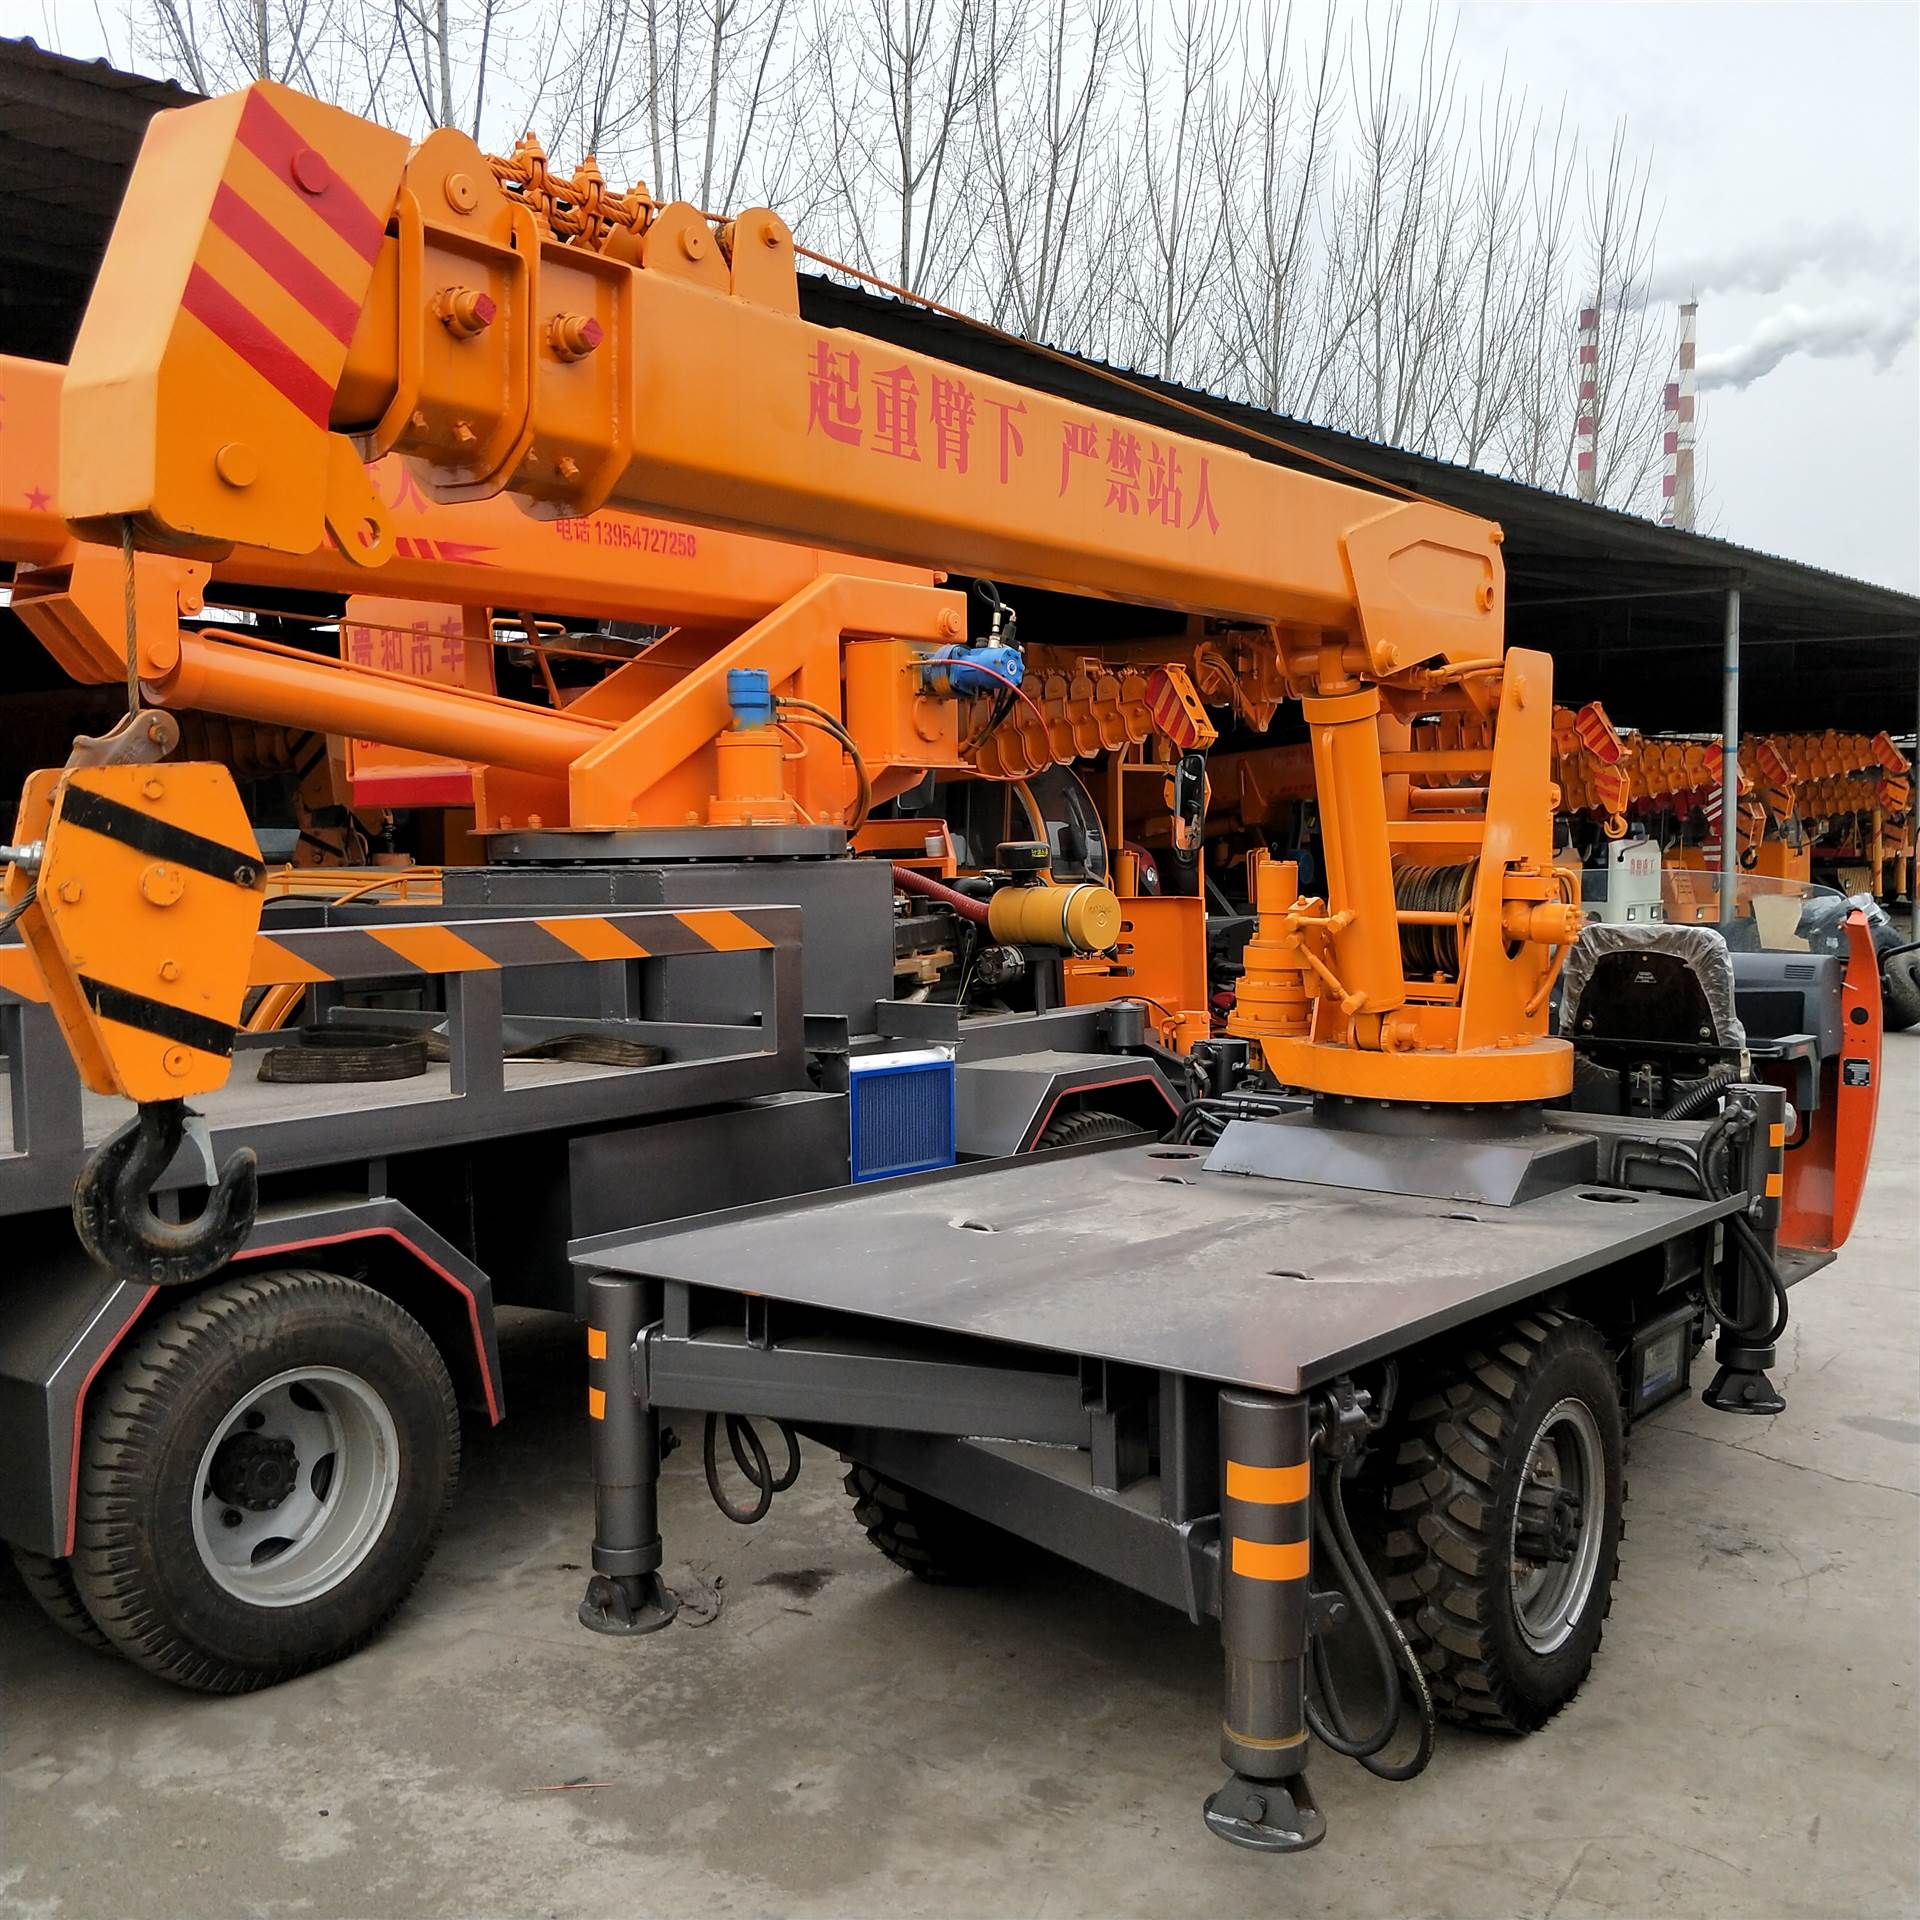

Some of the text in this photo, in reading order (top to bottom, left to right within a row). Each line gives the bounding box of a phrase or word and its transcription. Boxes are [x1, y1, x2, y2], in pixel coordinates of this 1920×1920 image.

[807, 340, 1221, 535] 起重臂下 严禁站人
[556, 518, 697, 559] 电话 13954727258
